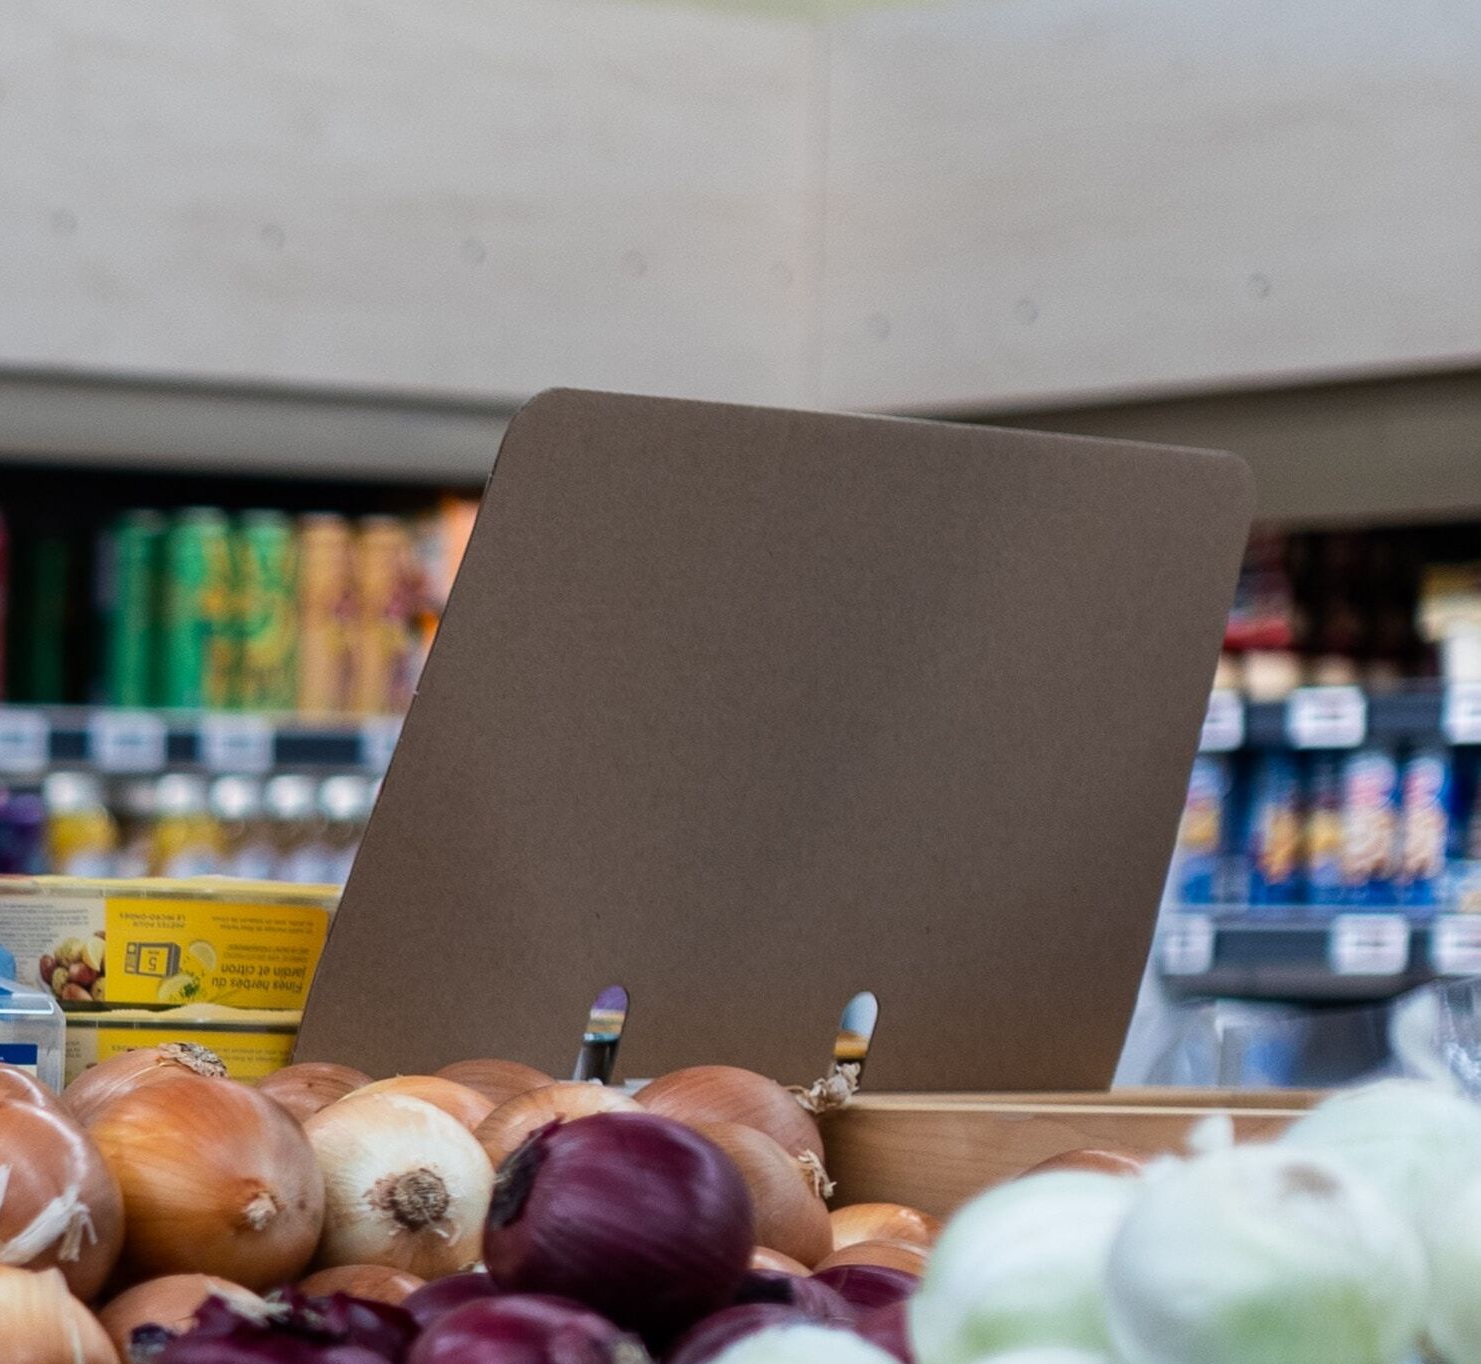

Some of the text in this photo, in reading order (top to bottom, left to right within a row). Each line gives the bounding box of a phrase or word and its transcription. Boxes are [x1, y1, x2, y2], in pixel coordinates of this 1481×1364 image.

[148, 958, 157, 972] 5
[221, 965, 307, 978] jardin et citron
[211, 977, 304, 993] Fines herbes du
